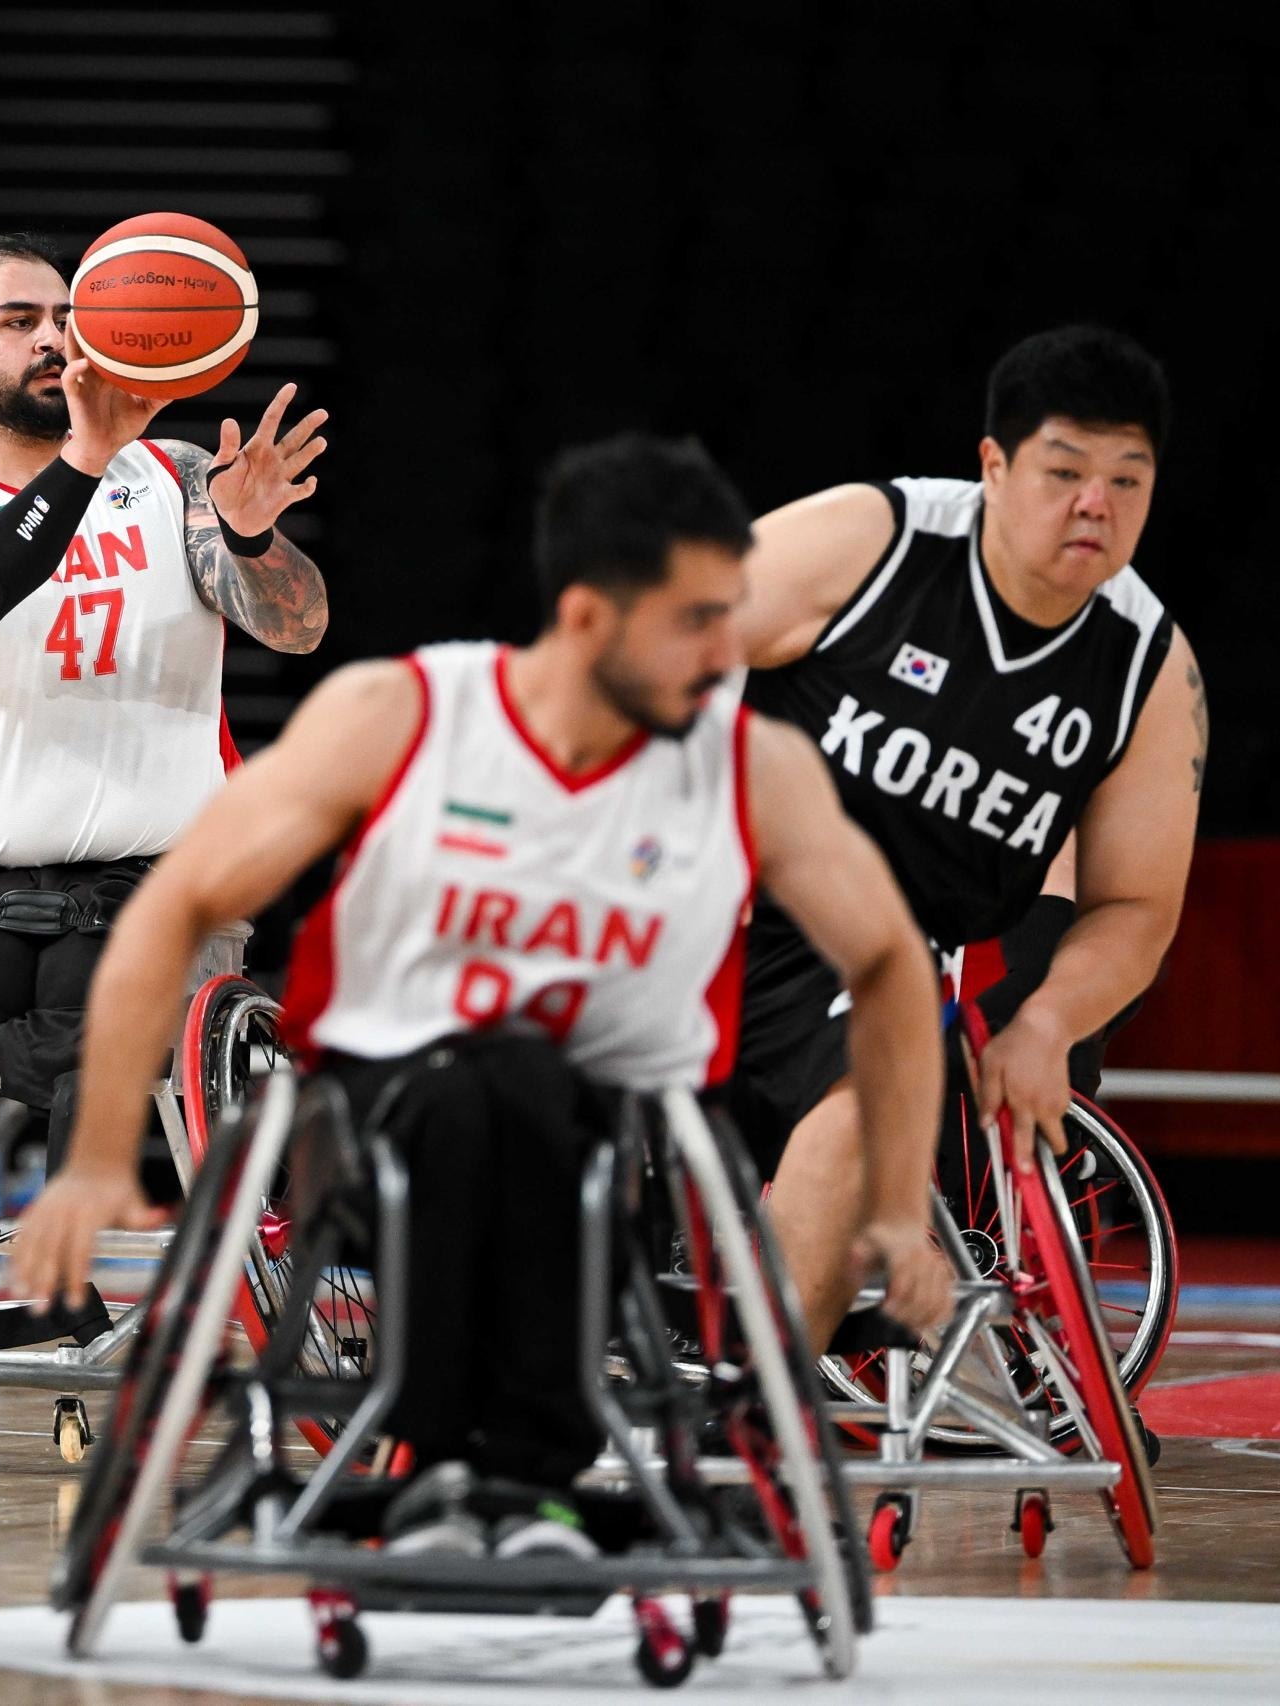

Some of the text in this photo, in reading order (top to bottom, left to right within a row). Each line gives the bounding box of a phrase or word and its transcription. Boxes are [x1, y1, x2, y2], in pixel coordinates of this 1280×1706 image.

[90, 271, 218, 294] Aichi-Nagoya 2026
[111, 330, 193, 351] molten
[51, 525, 148, 583] AN
[45, 587, 125, 681] 47
[1013, 694, 1092, 769] 40
[820, 694, 1062, 856] KOREA
[435, 883, 664, 968] IRAN
